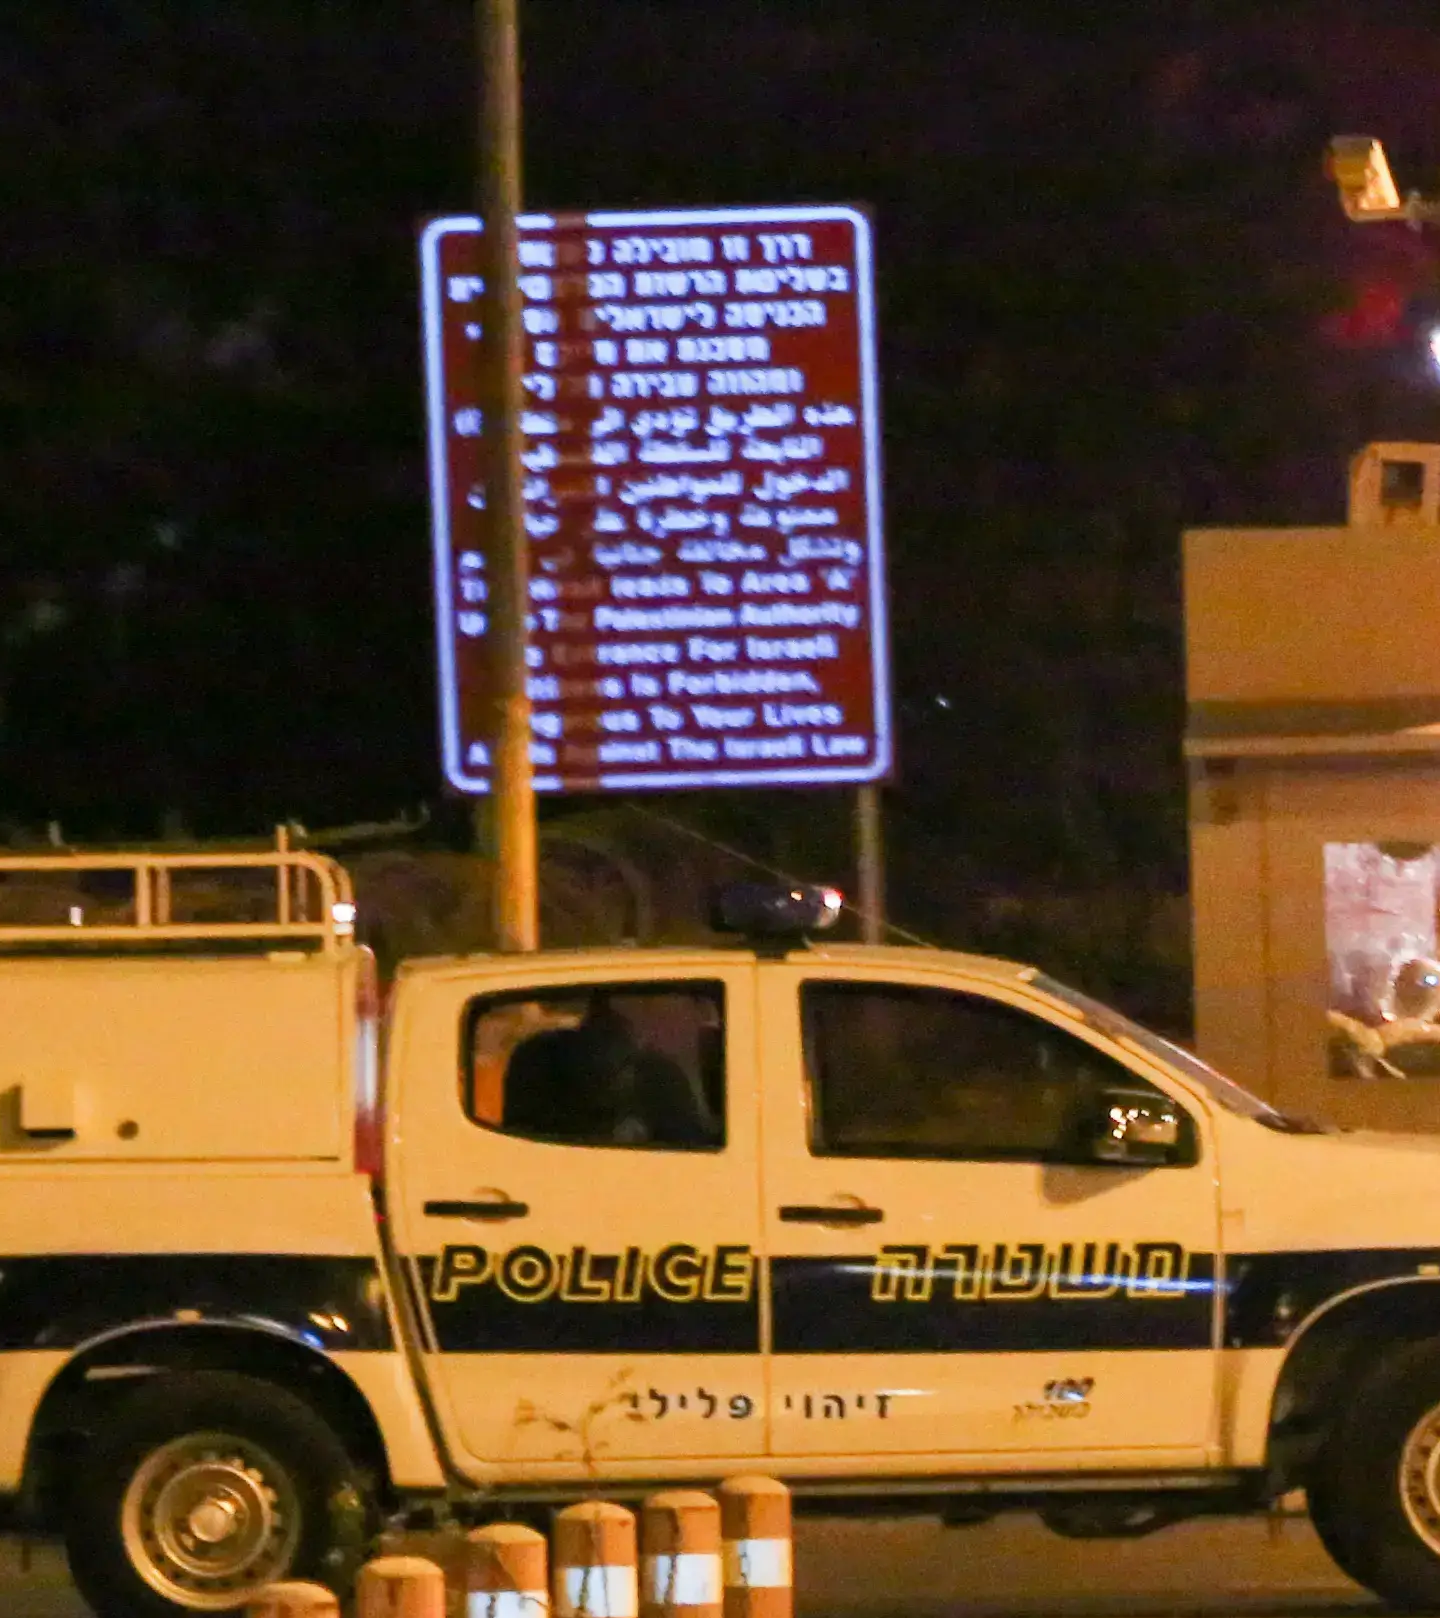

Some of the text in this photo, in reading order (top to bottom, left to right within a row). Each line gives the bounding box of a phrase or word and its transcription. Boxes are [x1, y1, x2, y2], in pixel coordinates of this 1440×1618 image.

[762, 703, 843, 727] Lives
[433, 1243, 756, 1303] POLICE
[870, 1240, 1192, 1303] משטרה
[785, 1393, 893, 1419] זיהוי
